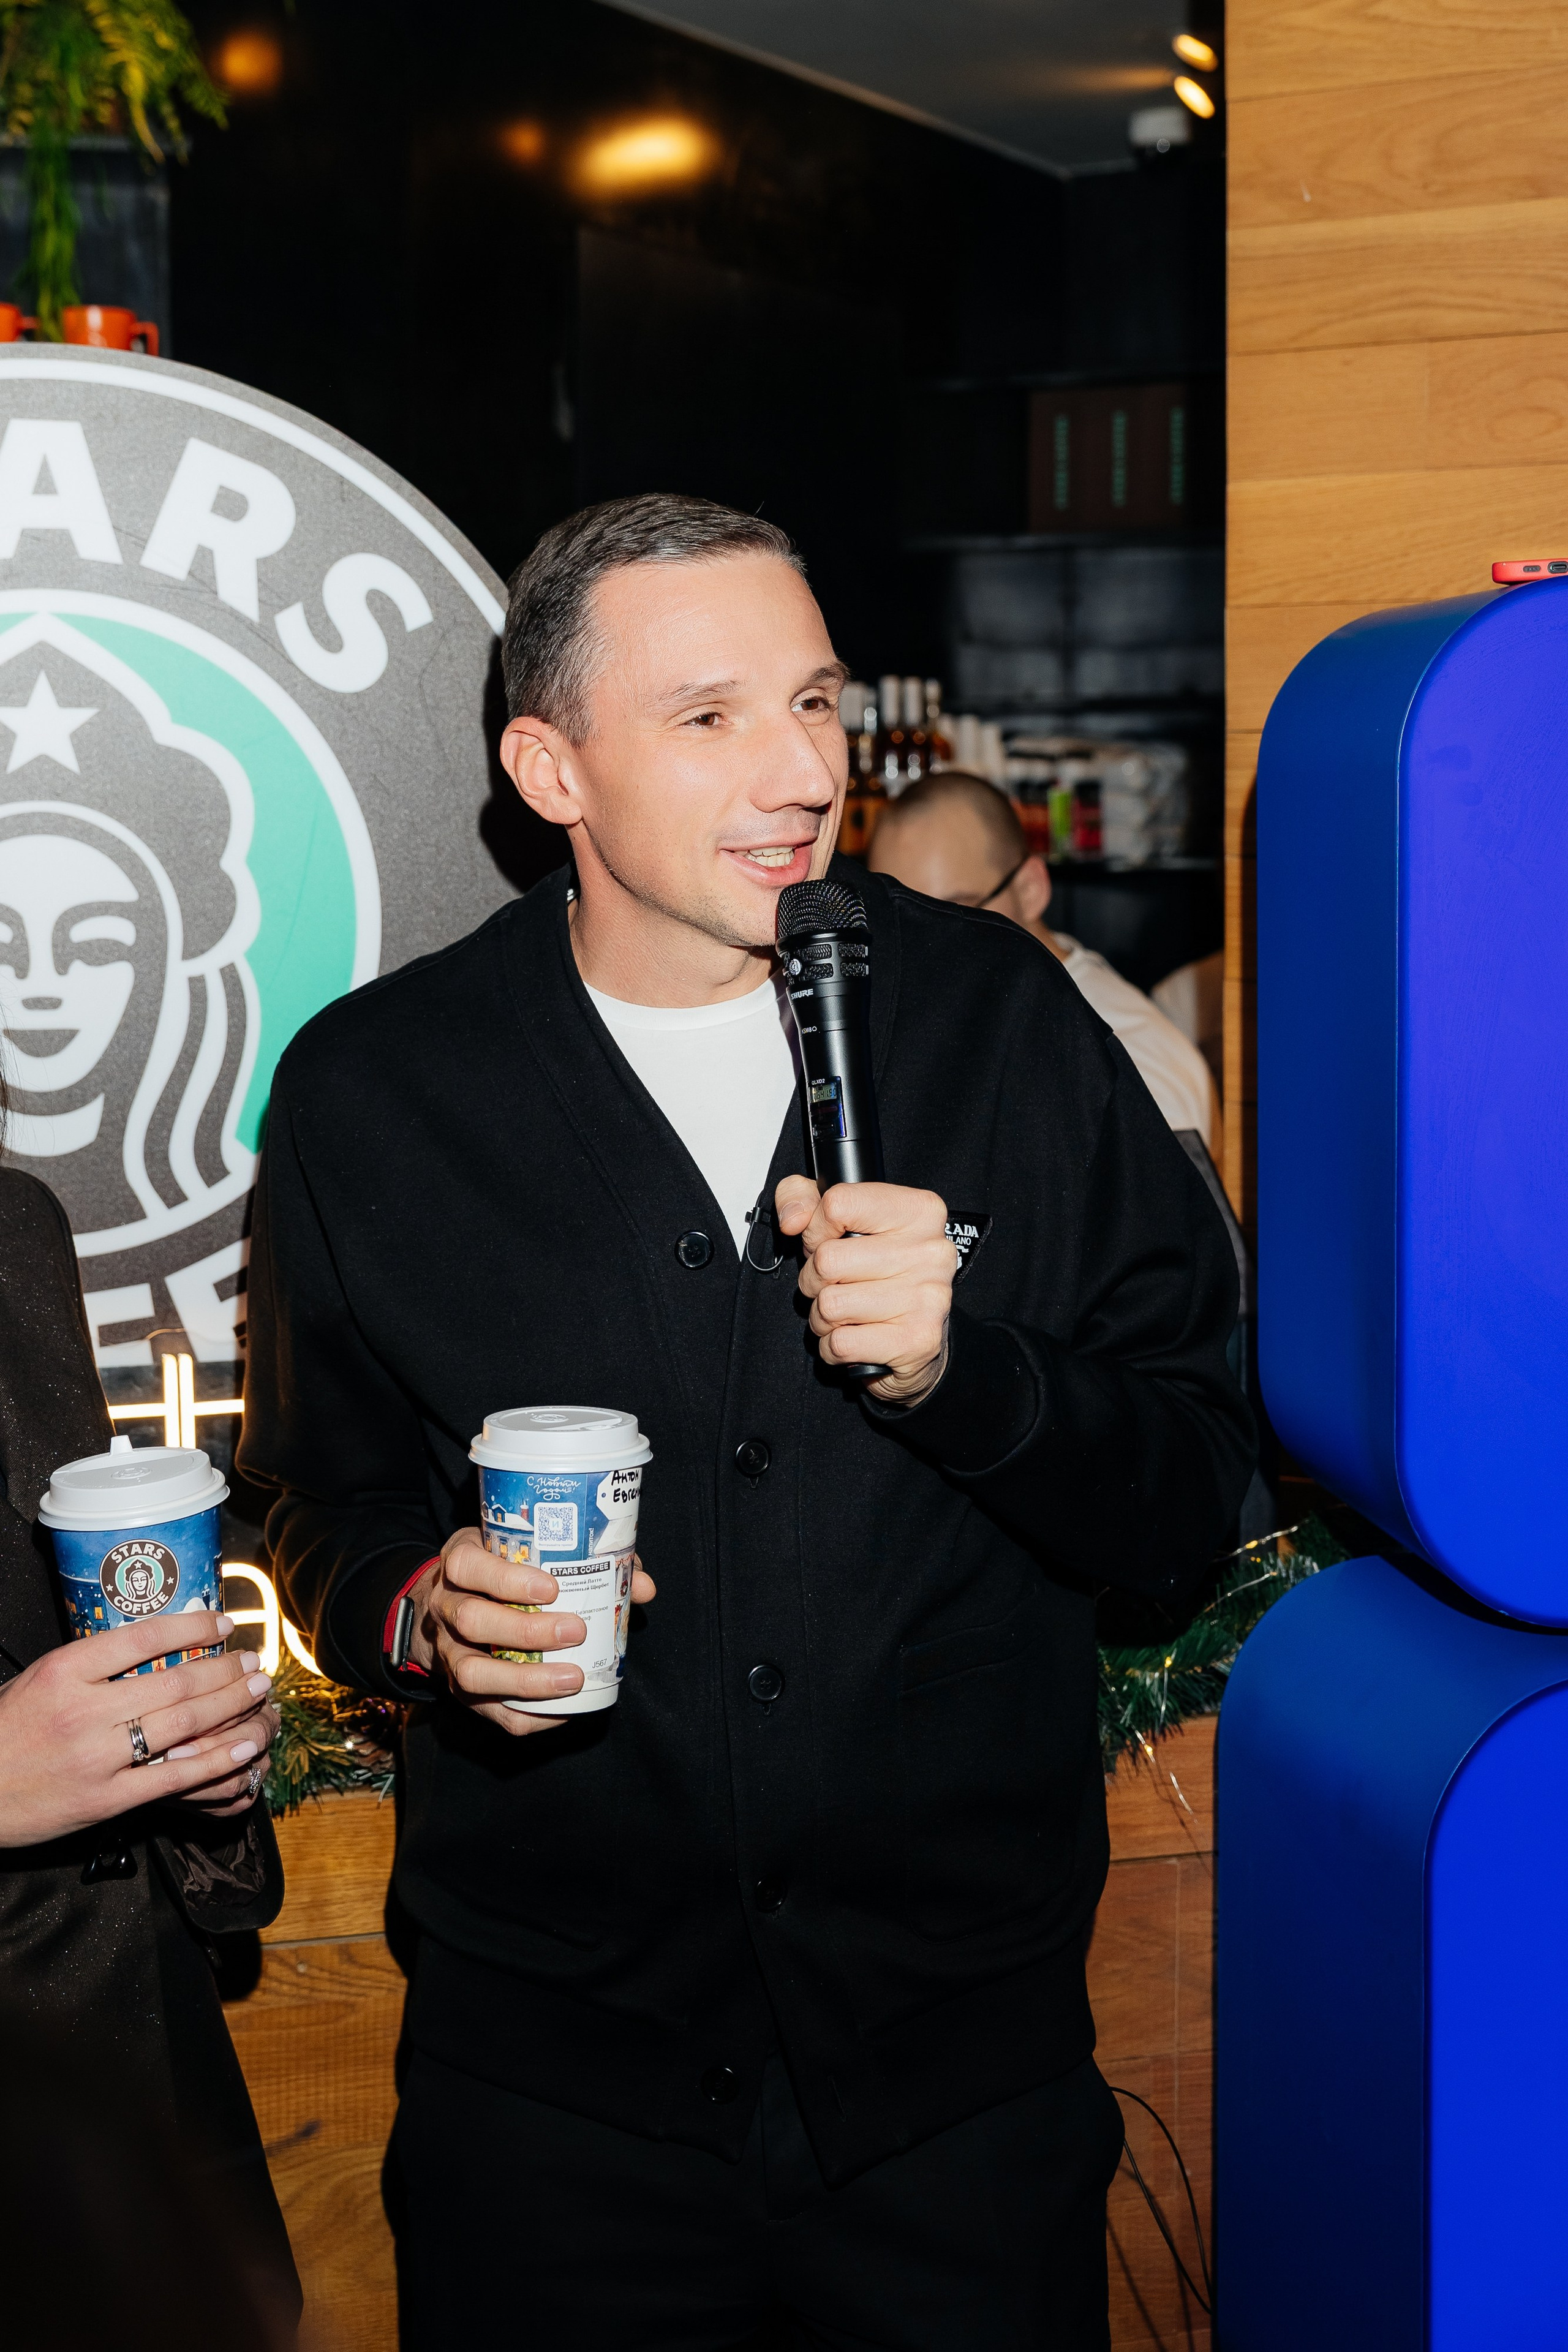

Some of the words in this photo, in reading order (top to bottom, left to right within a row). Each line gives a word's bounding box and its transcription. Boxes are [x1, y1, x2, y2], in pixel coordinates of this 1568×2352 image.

[790, 988, 813, 1000] SHURE
[527, 1476, 534, 1486] С
[537, 1476, 581, 1488] Новым
[611, 1470, 639, 1486] Антон
[111, 1543, 165, 1564] STARS
[551, 1567, 578, 1576] STARS
[580, 1562, 609, 1574] COFFEE
[562, 1578, 587, 1587] Средний
[113, 1592, 169, 1615] COFFEE
[592, 1658, 608, 1669] J567
